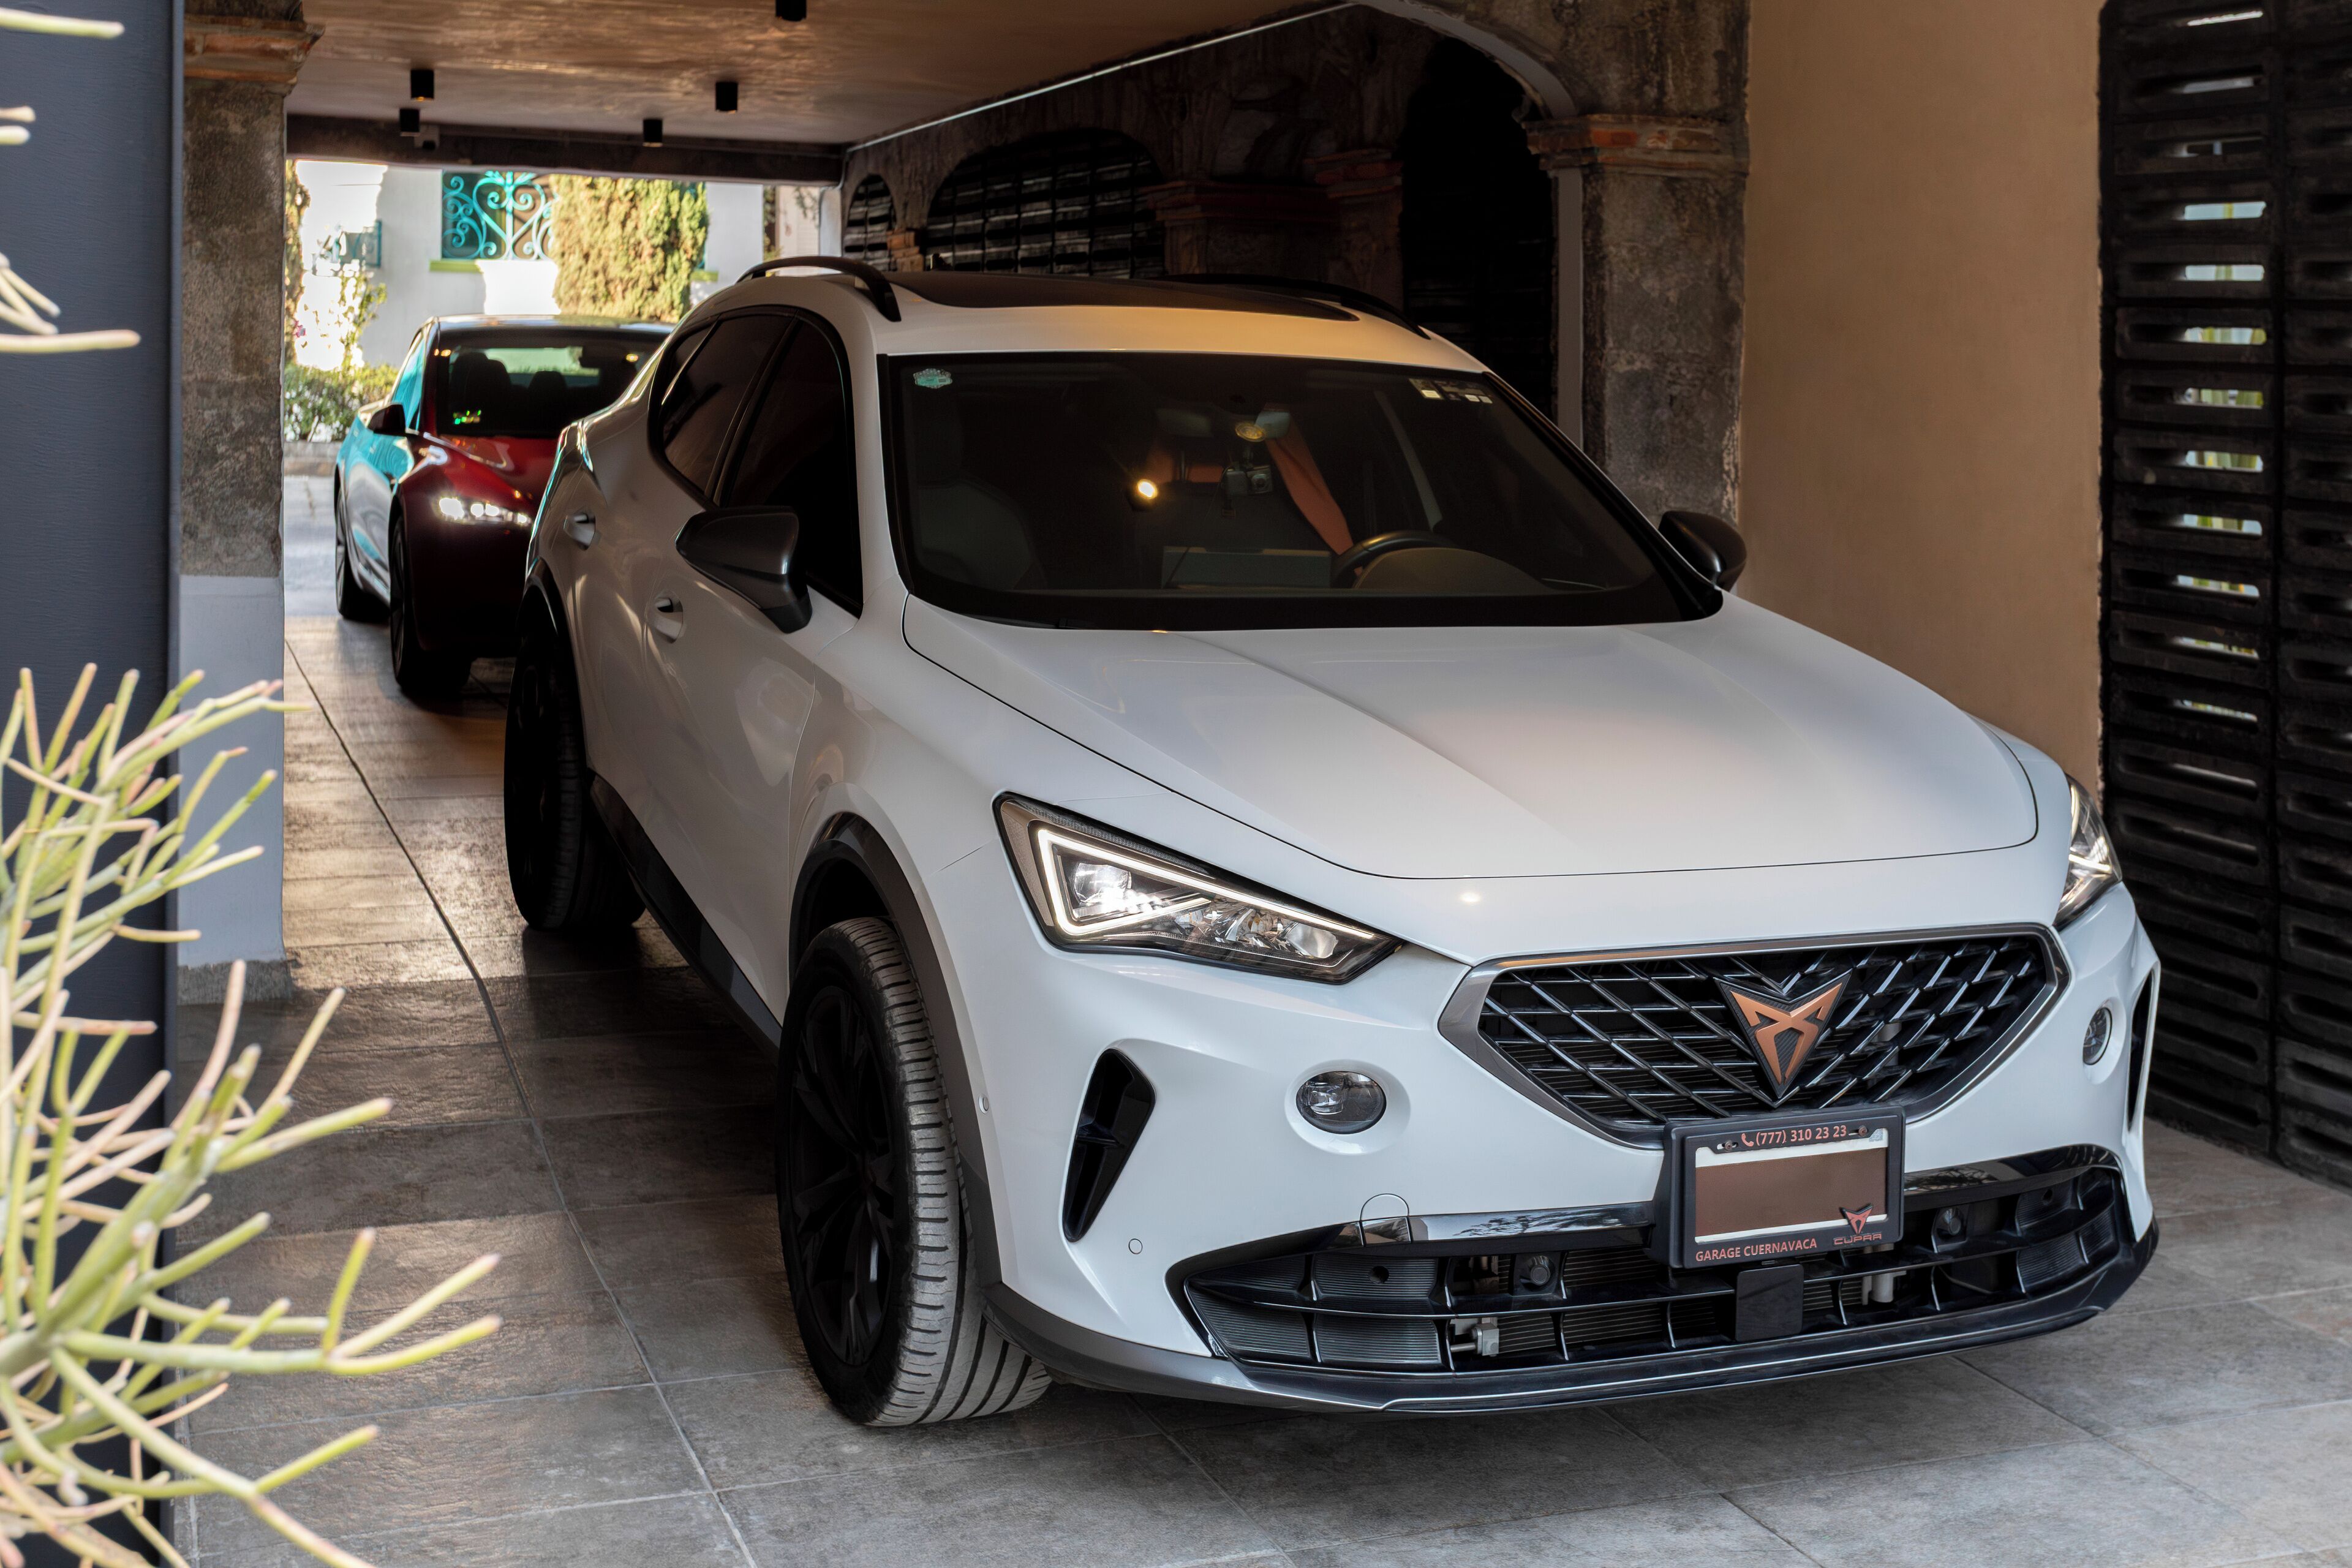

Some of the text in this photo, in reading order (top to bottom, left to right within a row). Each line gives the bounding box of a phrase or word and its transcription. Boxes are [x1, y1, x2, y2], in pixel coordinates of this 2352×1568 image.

[1756, 1125, 1847, 1146] (777) 310 23 23
[1833, 1232, 1882, 1245] CUPRA
[1695, 1238, 1817, 1262] GARAGE CUERNAVACA
